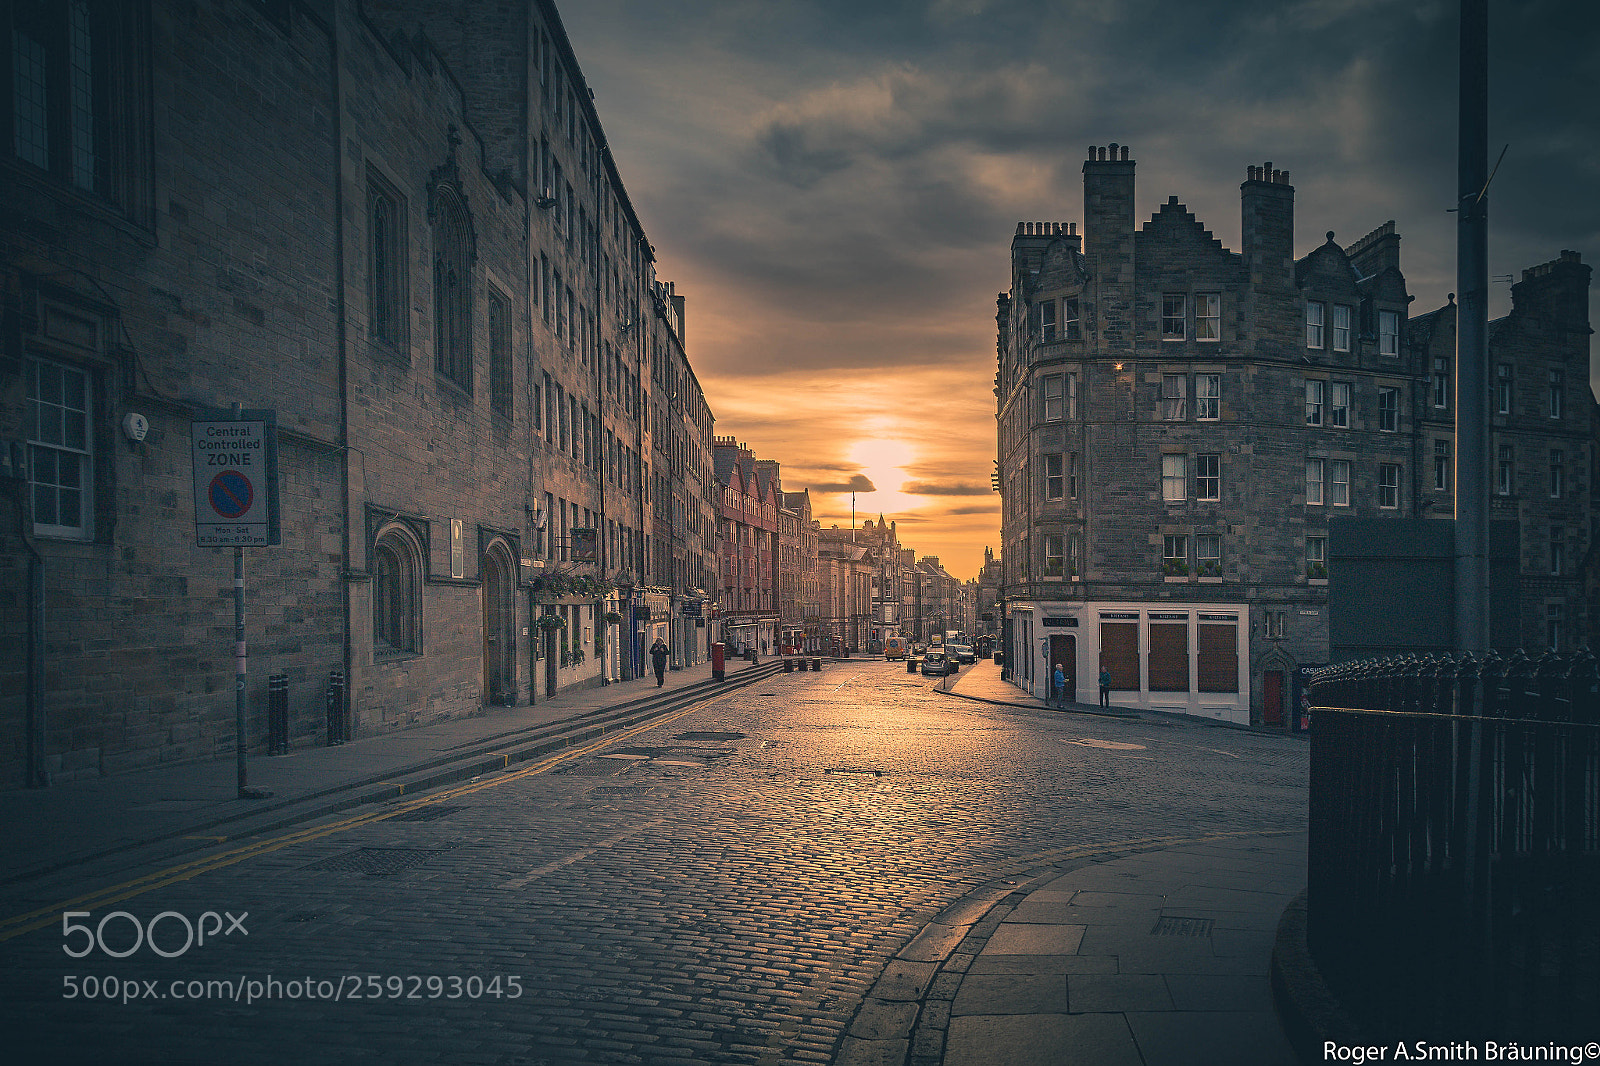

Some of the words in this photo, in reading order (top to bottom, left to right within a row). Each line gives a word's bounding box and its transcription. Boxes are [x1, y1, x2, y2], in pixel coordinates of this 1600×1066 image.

[206, 426, 251, 437] Central
[198, 439, 260, 450] Controlled
[207, 453, 251, 466] ZONE
[215, 526, 231, 534] Mon
[236, 526, 249, 534] Sat
